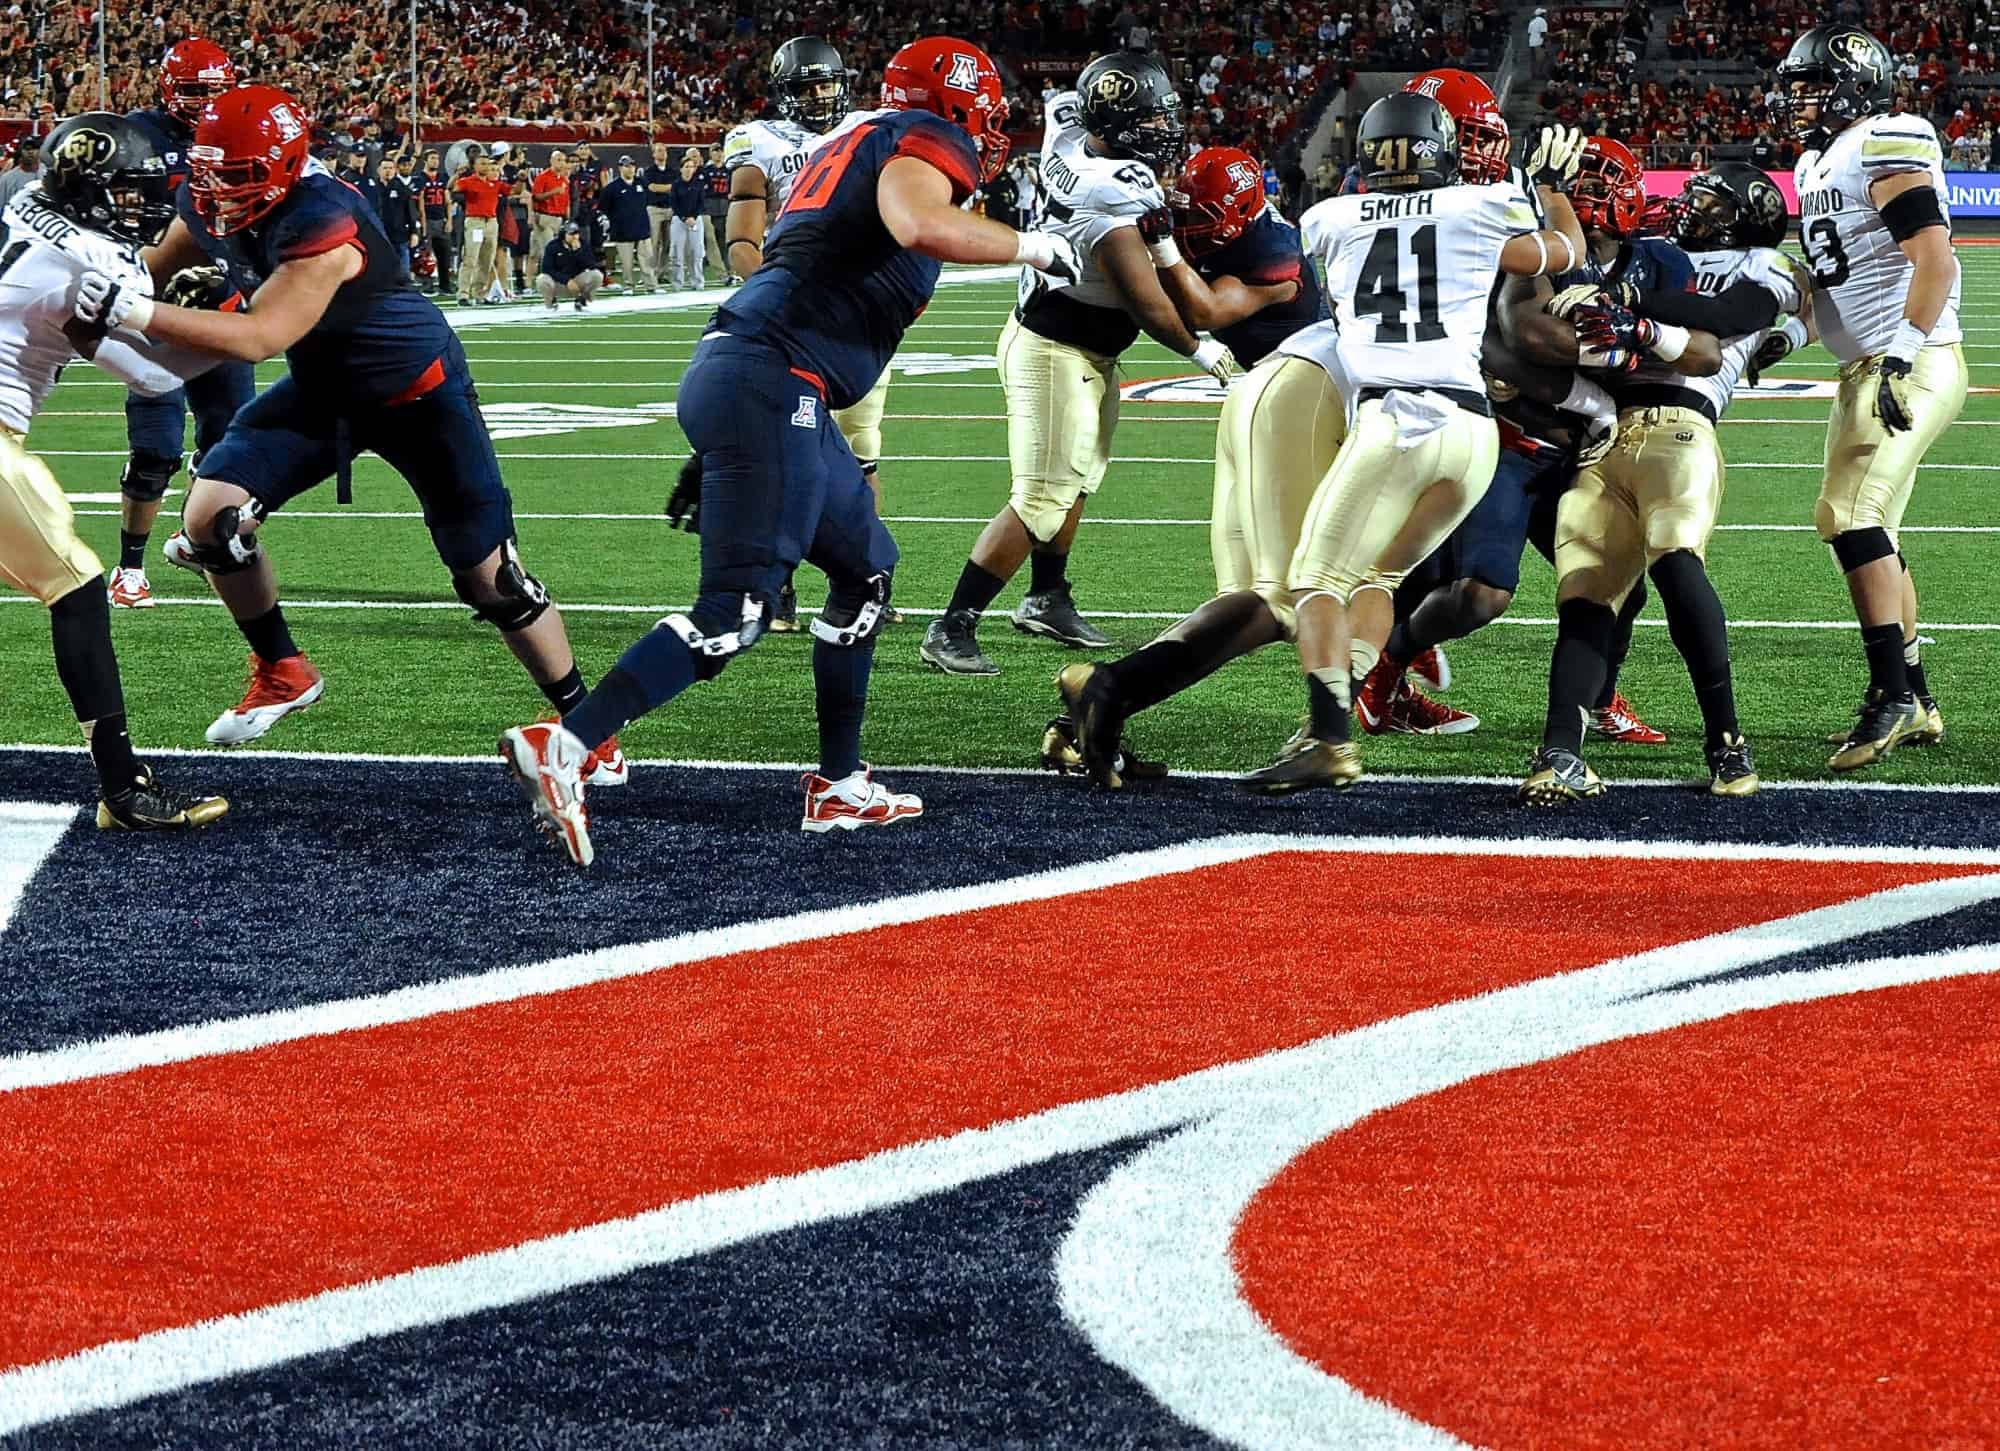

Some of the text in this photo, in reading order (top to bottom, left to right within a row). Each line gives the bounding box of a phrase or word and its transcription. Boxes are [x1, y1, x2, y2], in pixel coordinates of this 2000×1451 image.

[944, 52, 978, 95] A
[1376, 137, 1408, 172] 41
[1043, 152, 1080, 195] TUPOU
[1112, 163, 1155, 190] 55
[1225, 161, 1256, 196] A
[1360, 193, 1434, 222] SMITH
[1354, 224, 1449, 343] 41
[791, 395, 817, 430] A
